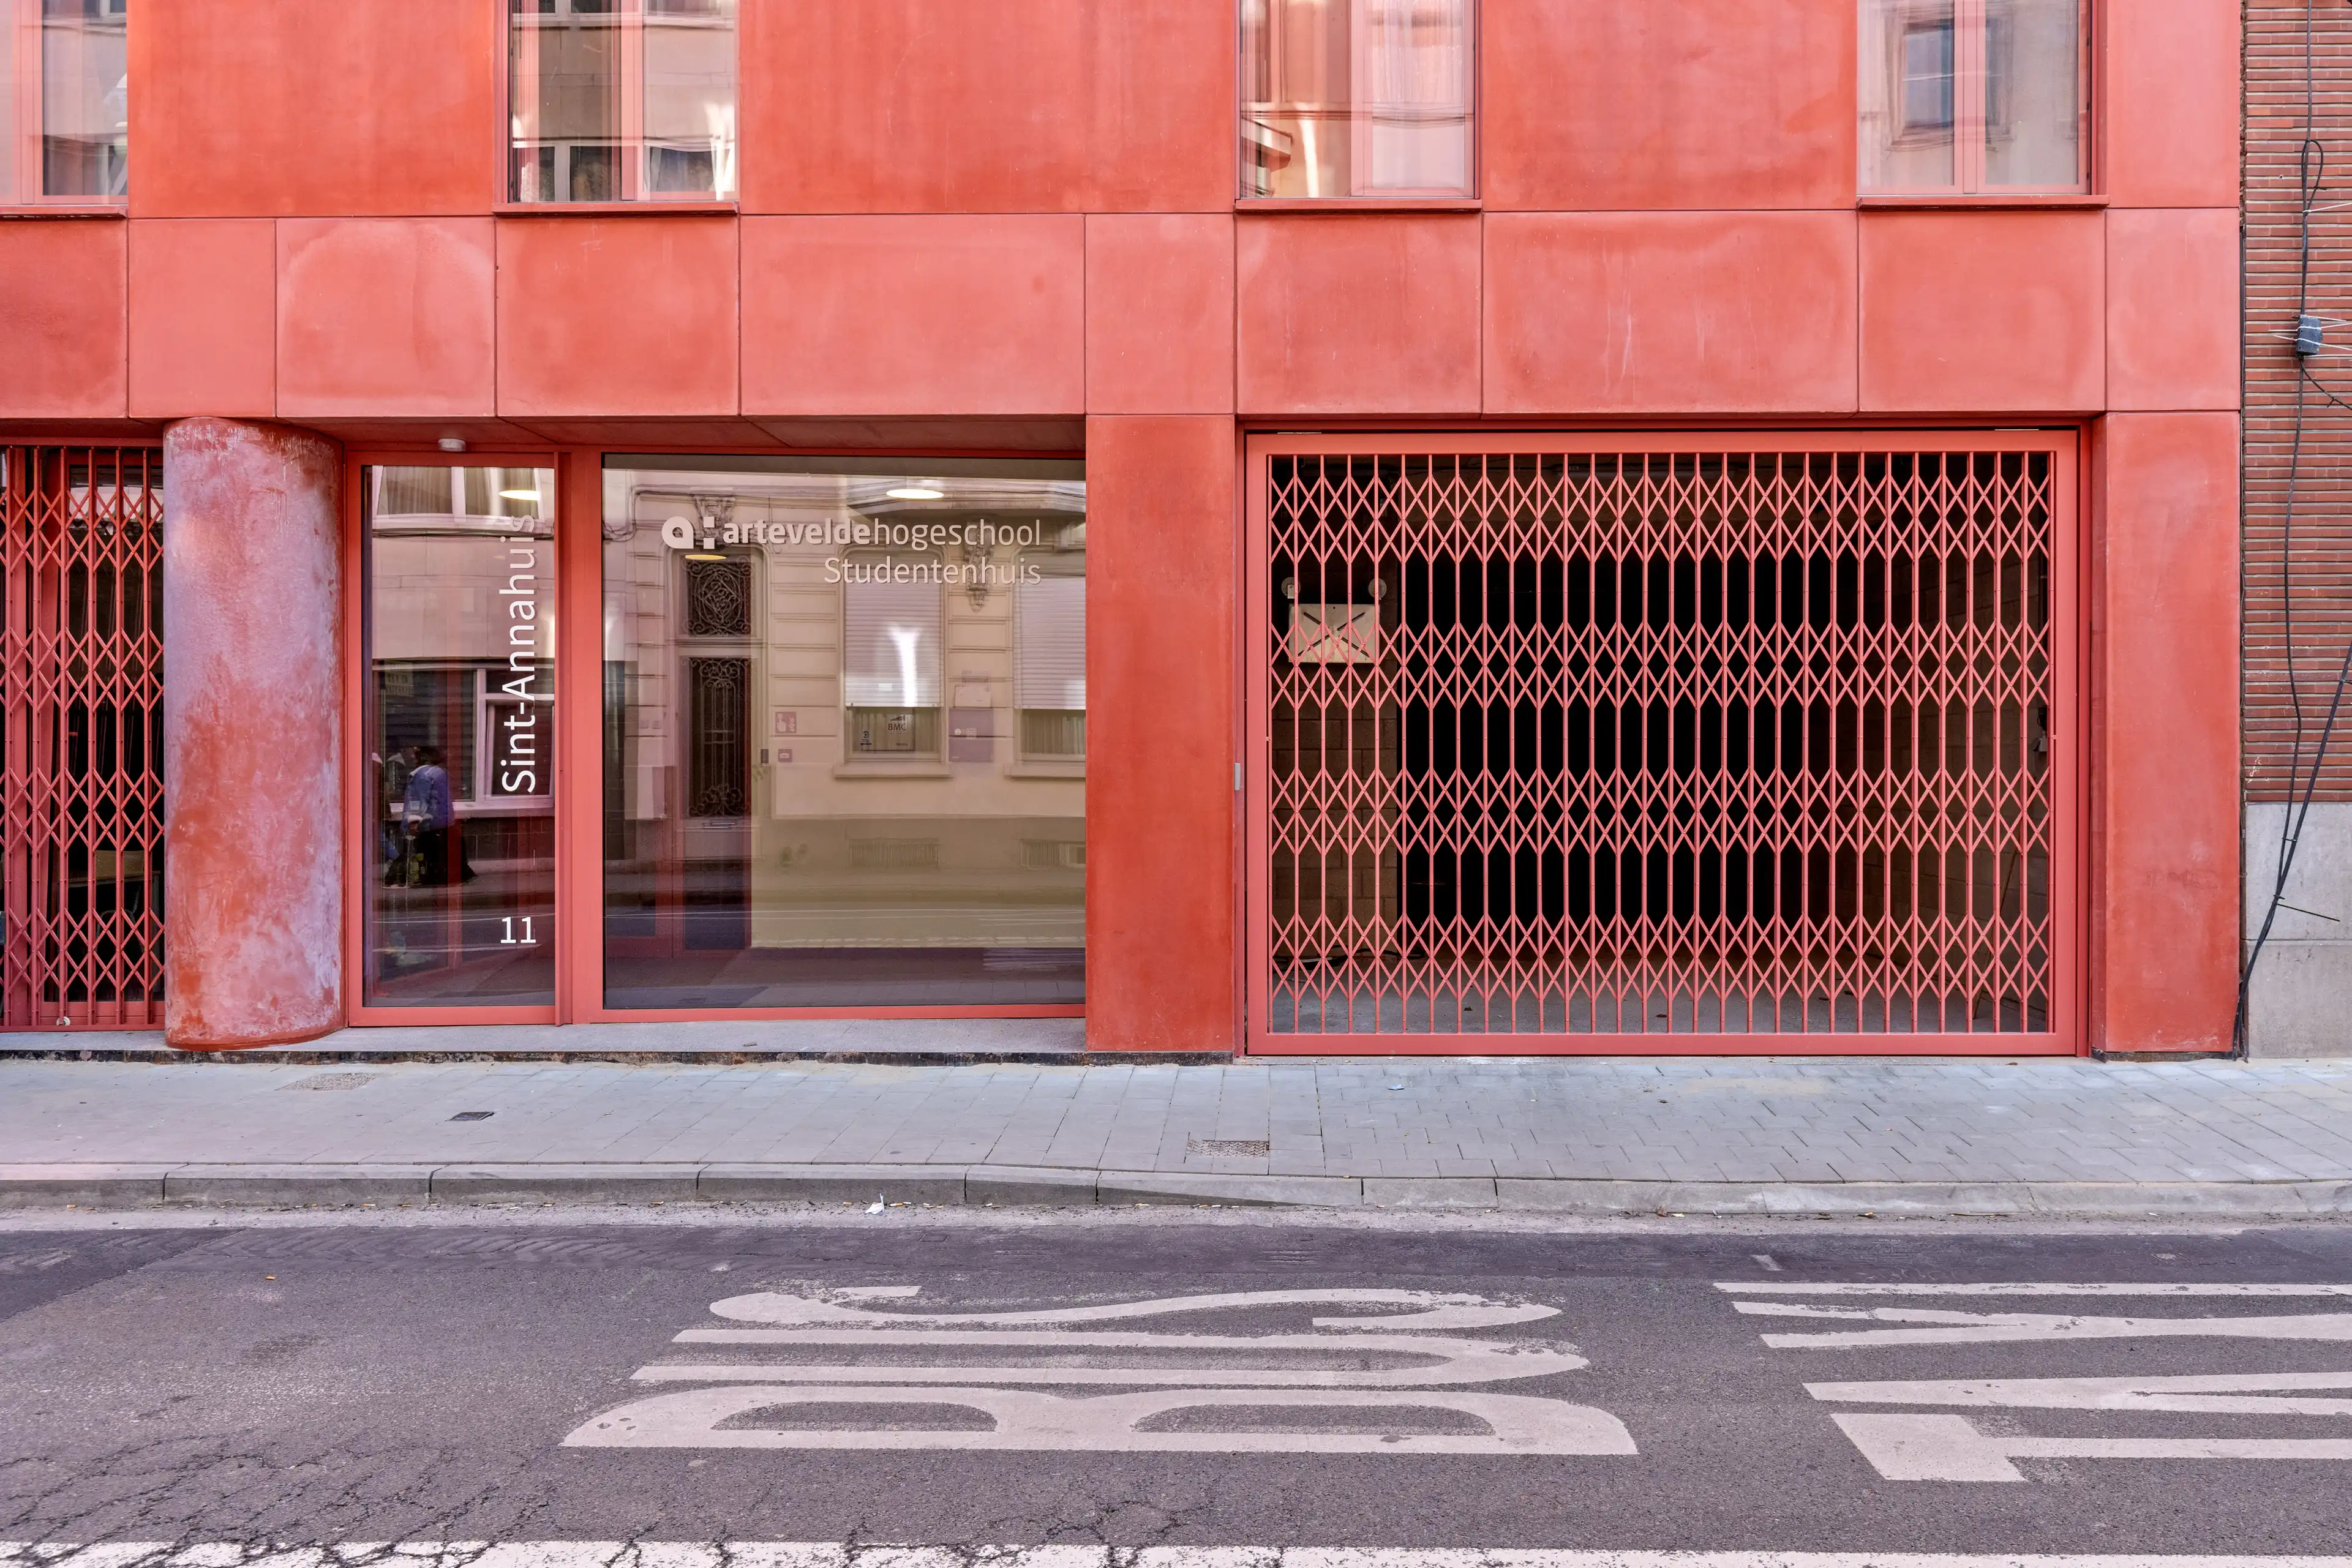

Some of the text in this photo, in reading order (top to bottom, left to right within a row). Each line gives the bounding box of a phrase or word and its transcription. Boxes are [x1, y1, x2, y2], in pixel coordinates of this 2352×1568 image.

[723, 518, 1040, 550] arteveldehogeschool
[824, 557, 1040, 585] Studentenhuis
[500, 514, 535, 793] Sint-Annahuis
[500, 916, 536, 943] 11
[562, 1288, 1638, 1456] BUS
